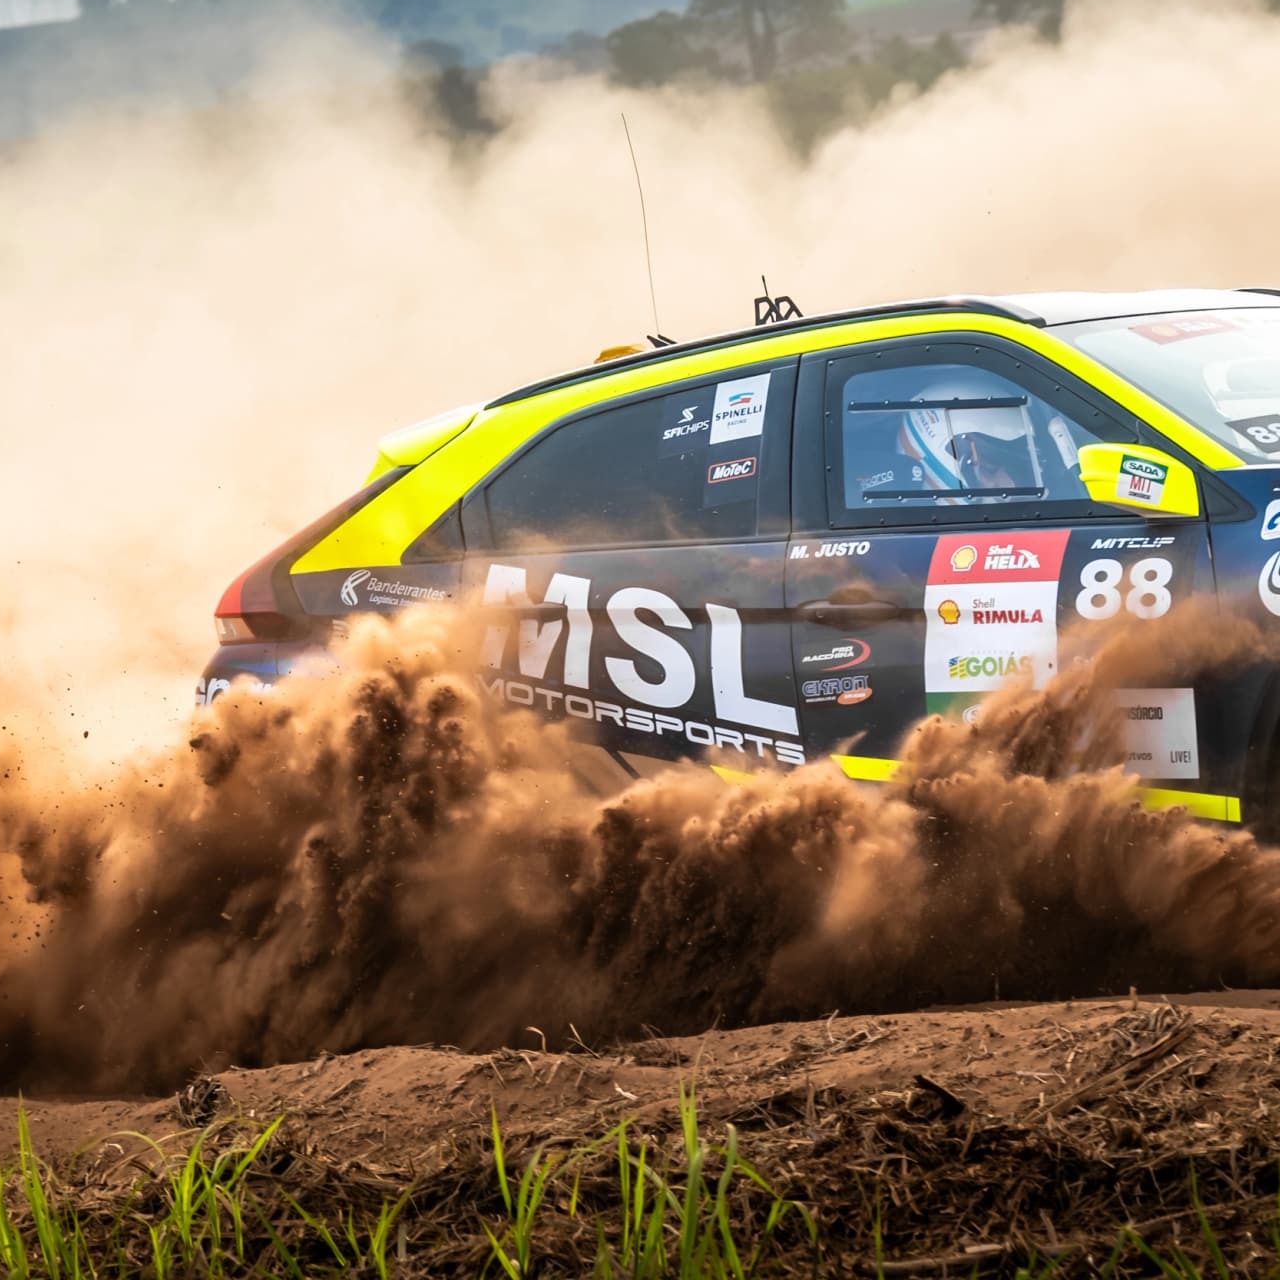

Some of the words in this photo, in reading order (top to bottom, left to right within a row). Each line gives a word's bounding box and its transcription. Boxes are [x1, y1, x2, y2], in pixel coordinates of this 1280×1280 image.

[715, 404, 763, 422] SPINELLI
[712, 460, 752, 480] MoTeC
[1129, 462, 1159, 477] SADA
[790, 546, 809, 560] M.
[814, 541, 870, 558] JUSTO
[988, 544, 1014, 555] Shell
[1091, 537, 1175, 549] MITCUP
[984, 549, 1040, 570] HELIX
[367, 577, 448, 600] Bandeirantes
[1076, 557, 1173, 620] 88
[972, 598, 995, 609] Shell
[973, 609, 1043, 624] RIMULA
[480, 564, 800, 736] MSL
[476, 673, 806, 765] MOTORSPORTS
